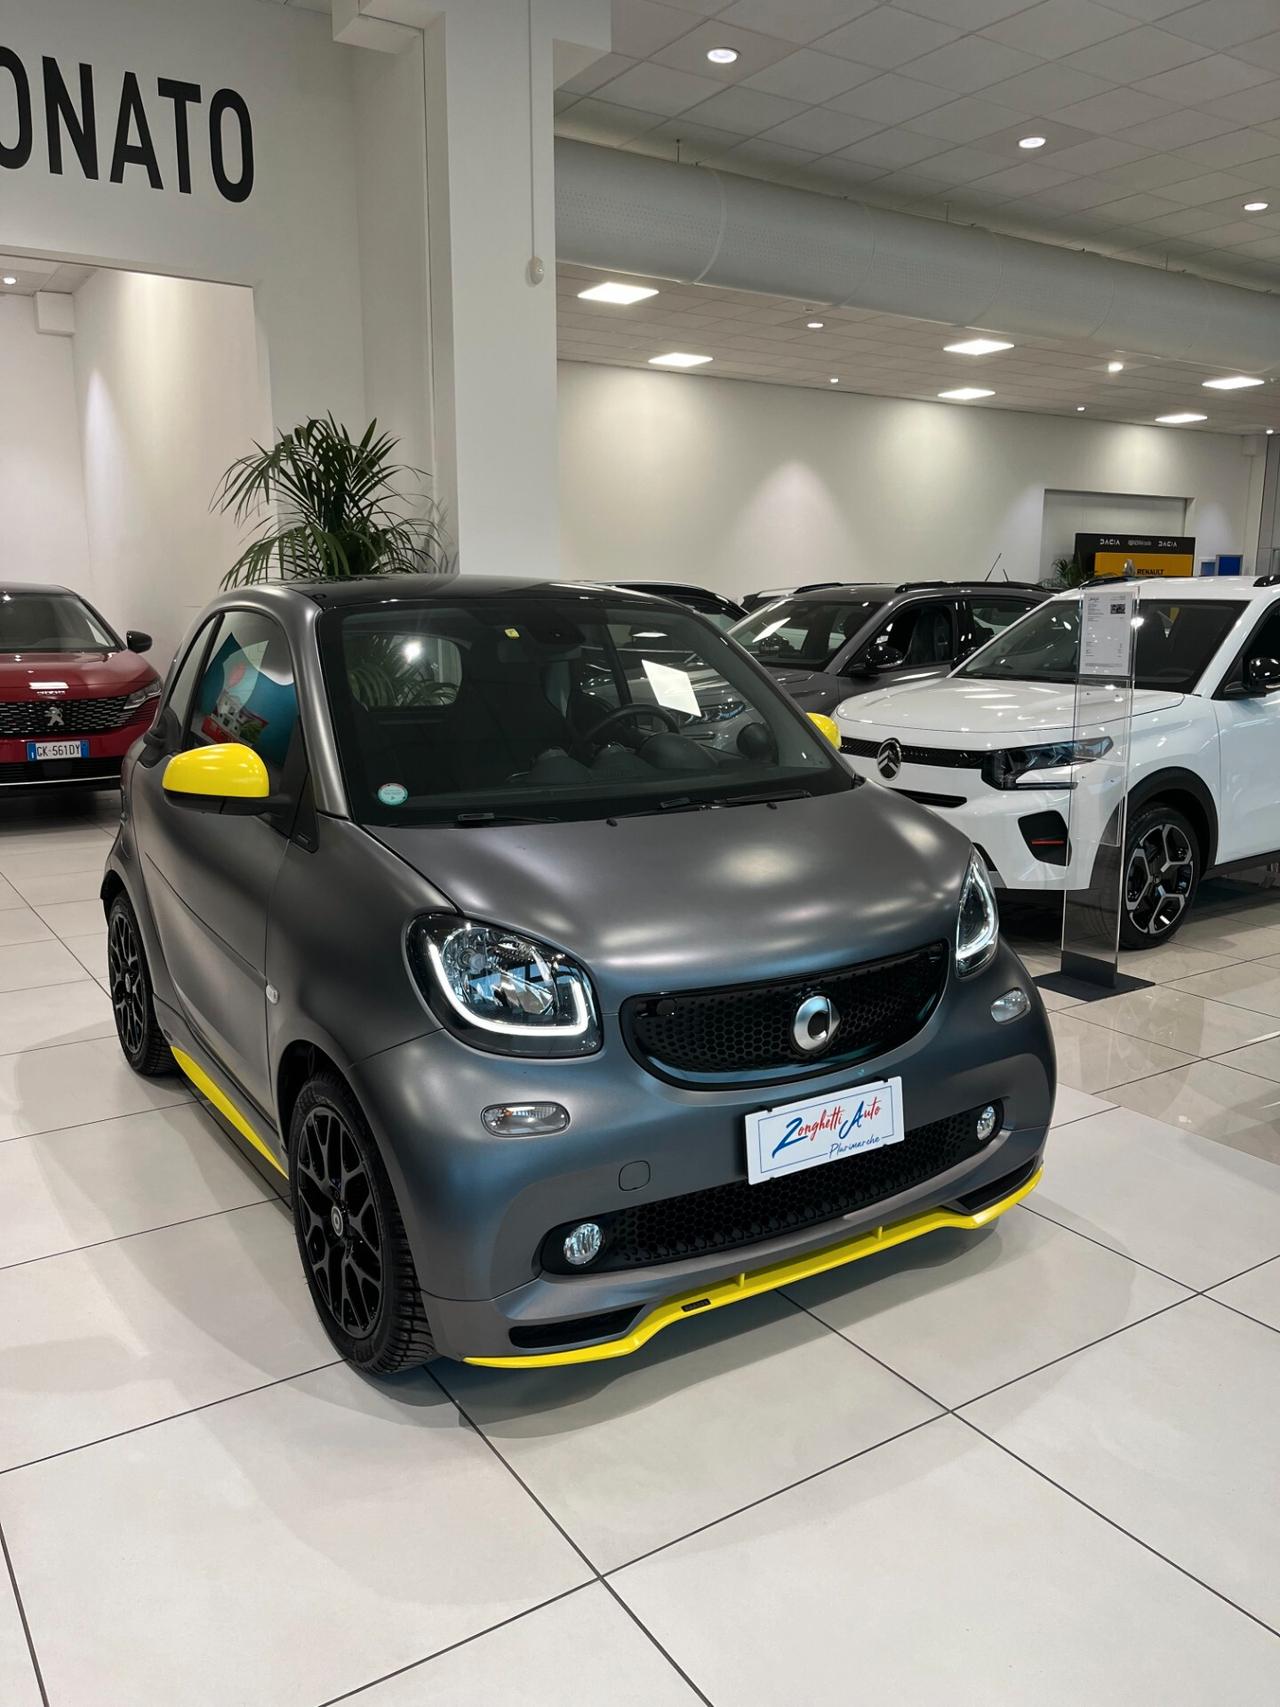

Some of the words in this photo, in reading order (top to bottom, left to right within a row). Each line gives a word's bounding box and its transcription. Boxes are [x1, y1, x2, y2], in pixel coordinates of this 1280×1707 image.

[0, 46, 254, 203] ONATO
[1136, 568, 1164, 576] RENAULT
[771, 1106, 844, 1159] Zonghetti
[838, 1096, 882, 1139] Auto
[828, 1134, 881, 1159] Plurimarche
